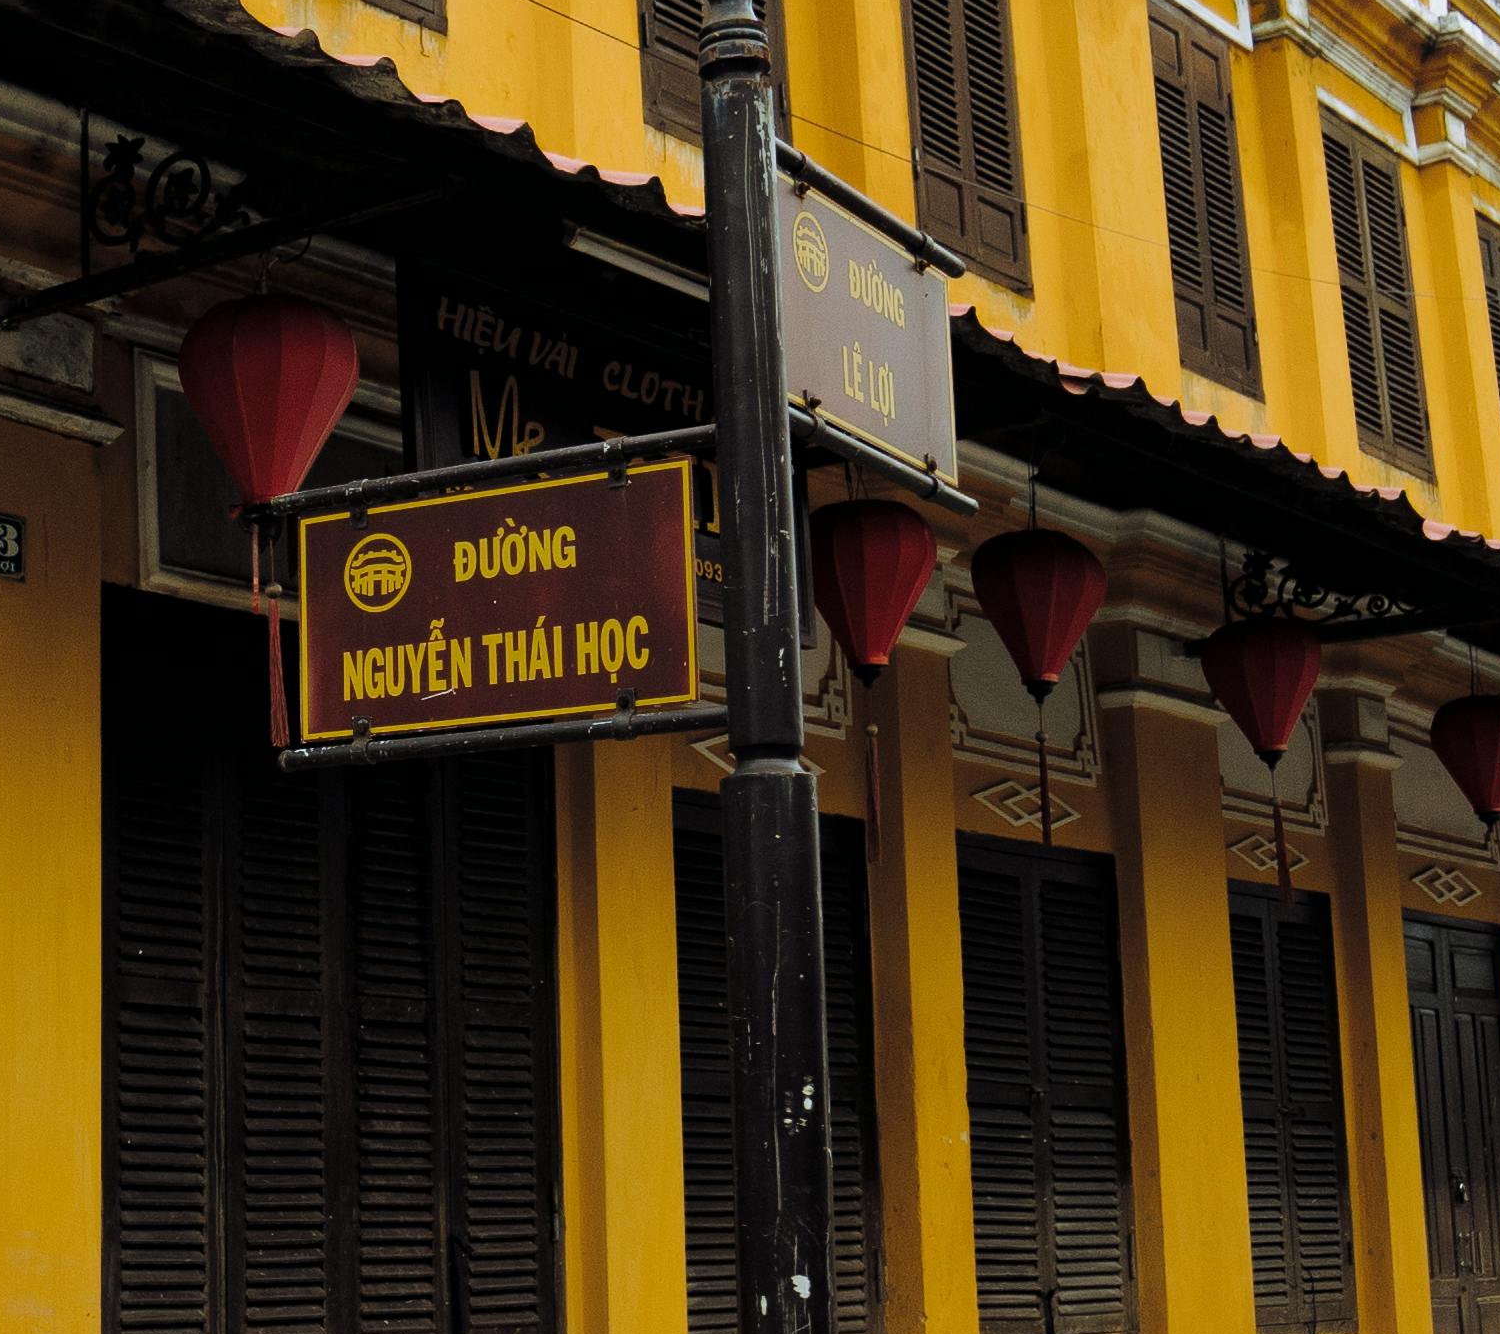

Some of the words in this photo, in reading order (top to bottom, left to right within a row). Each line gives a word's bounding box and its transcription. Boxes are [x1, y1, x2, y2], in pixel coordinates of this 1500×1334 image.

[849, 259, 905, 330] ĐƯỜNG
[603, 361, 704, 420] CLOTH
[842, 341, 864, 403] LÊ
[868, 361, 896, 427] LỢI
[453, 518, 577, 583] ĐƯỜNG
[343, 617, 472, 701] NGUYỄN
[482, 616, 564, 685] THÁI
[576, 615, 649, 684] HỌC
